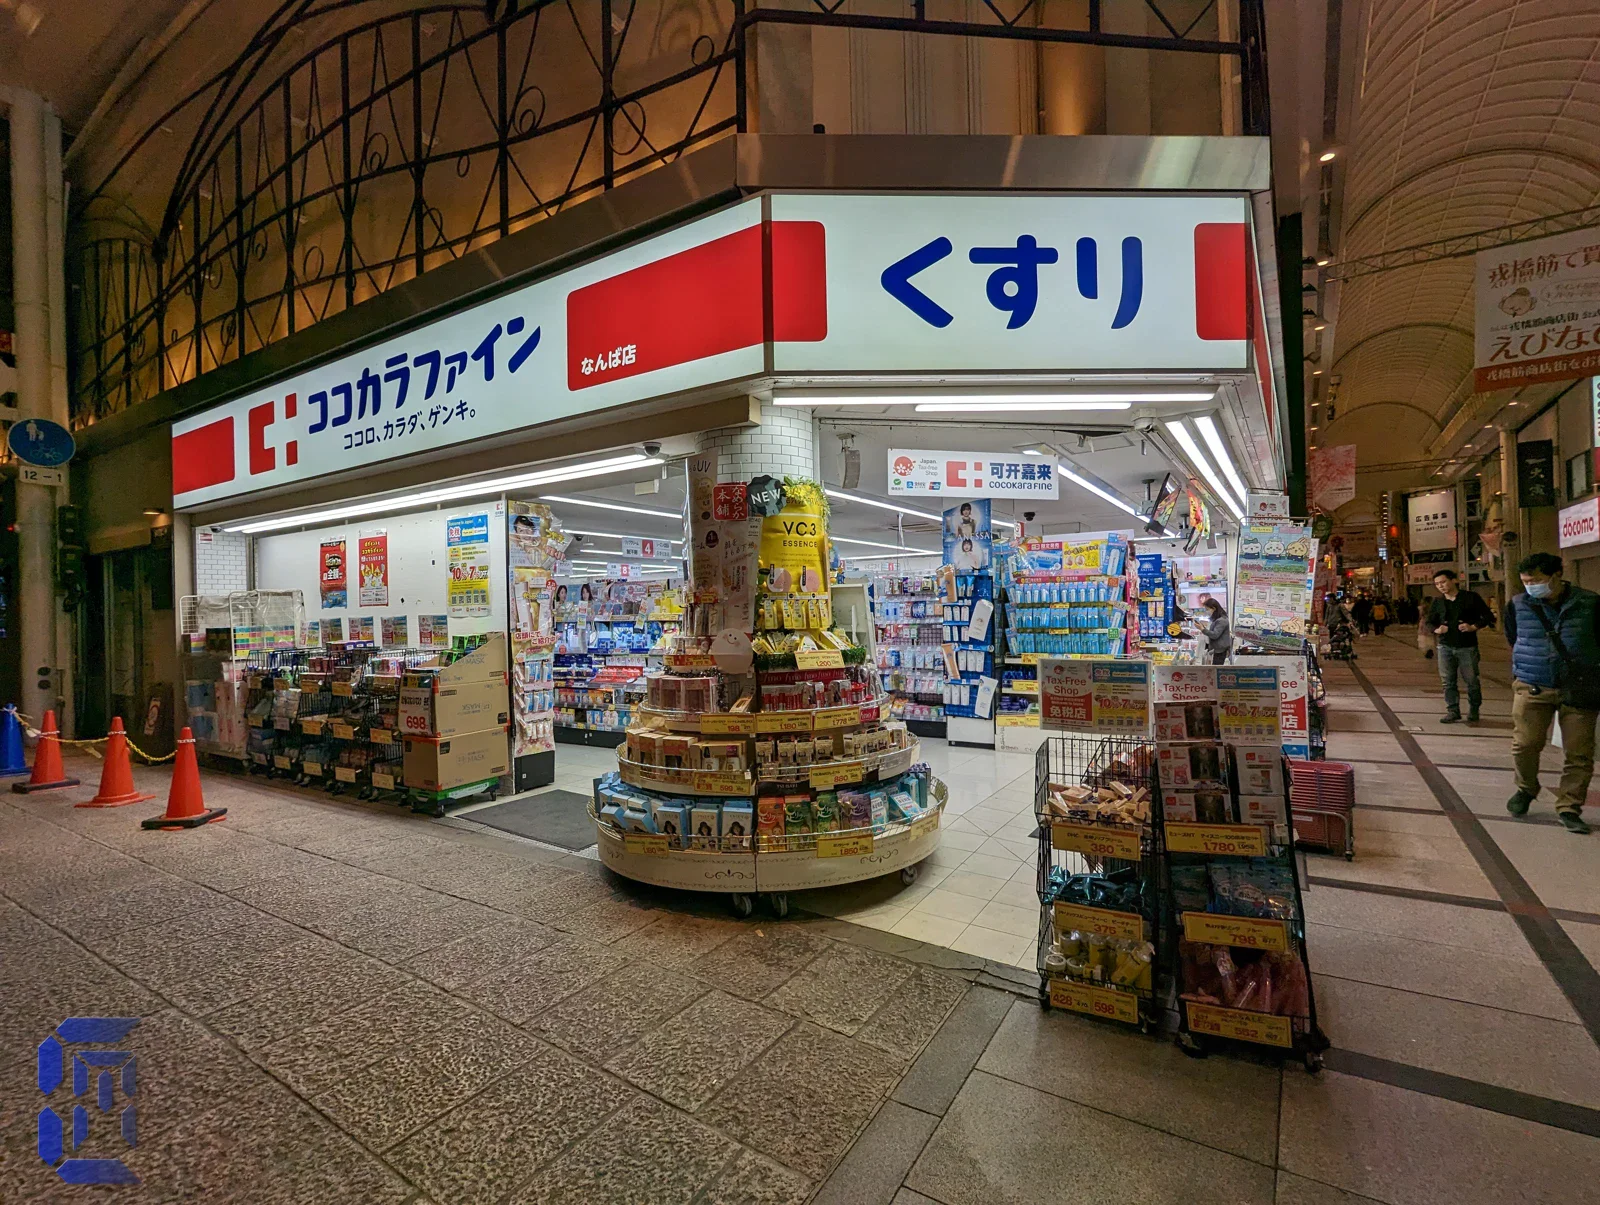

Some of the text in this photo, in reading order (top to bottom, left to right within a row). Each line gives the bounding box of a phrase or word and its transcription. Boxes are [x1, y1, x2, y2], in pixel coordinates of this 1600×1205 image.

[880, 233, 1144, 330] くすり
[581, 344, 637, 376] なんば店
[307, 316, 541, 435] ココカラファイン
[342, 400, 477, 451] ココロ、カラダ、ゲンキ。
[989, 462, 1052, 481] 可开嘉来
[717, 487, 745, 520] なめらか 本舗
[751, 488, 781, 505] NEW
[782, 521, 817, 537] VC3
[1562, 516, 1595, 538] docomo
[644, 543, 652, 555] 4
[782, 540, 818, 548] ESSENCE
[622, 566, 628, 574] 8
[1045, 675, 1087, 686] Tax-Free
[1053, 685, 1079, 697] Shop
[1162, 683, 1208, 693] Tax-Free
[1049, 705, 1087, 719] 免税店
[406, 715, 426, 730] 698
[1090, 843, 1115, 854] 380
[1203, 841, 1235, 852] 1,780
[1229, 933, 1257, 945] 798
[1052, 993, 1073, 1006] 428
[1094, 1001, 1115, 1015] 598
